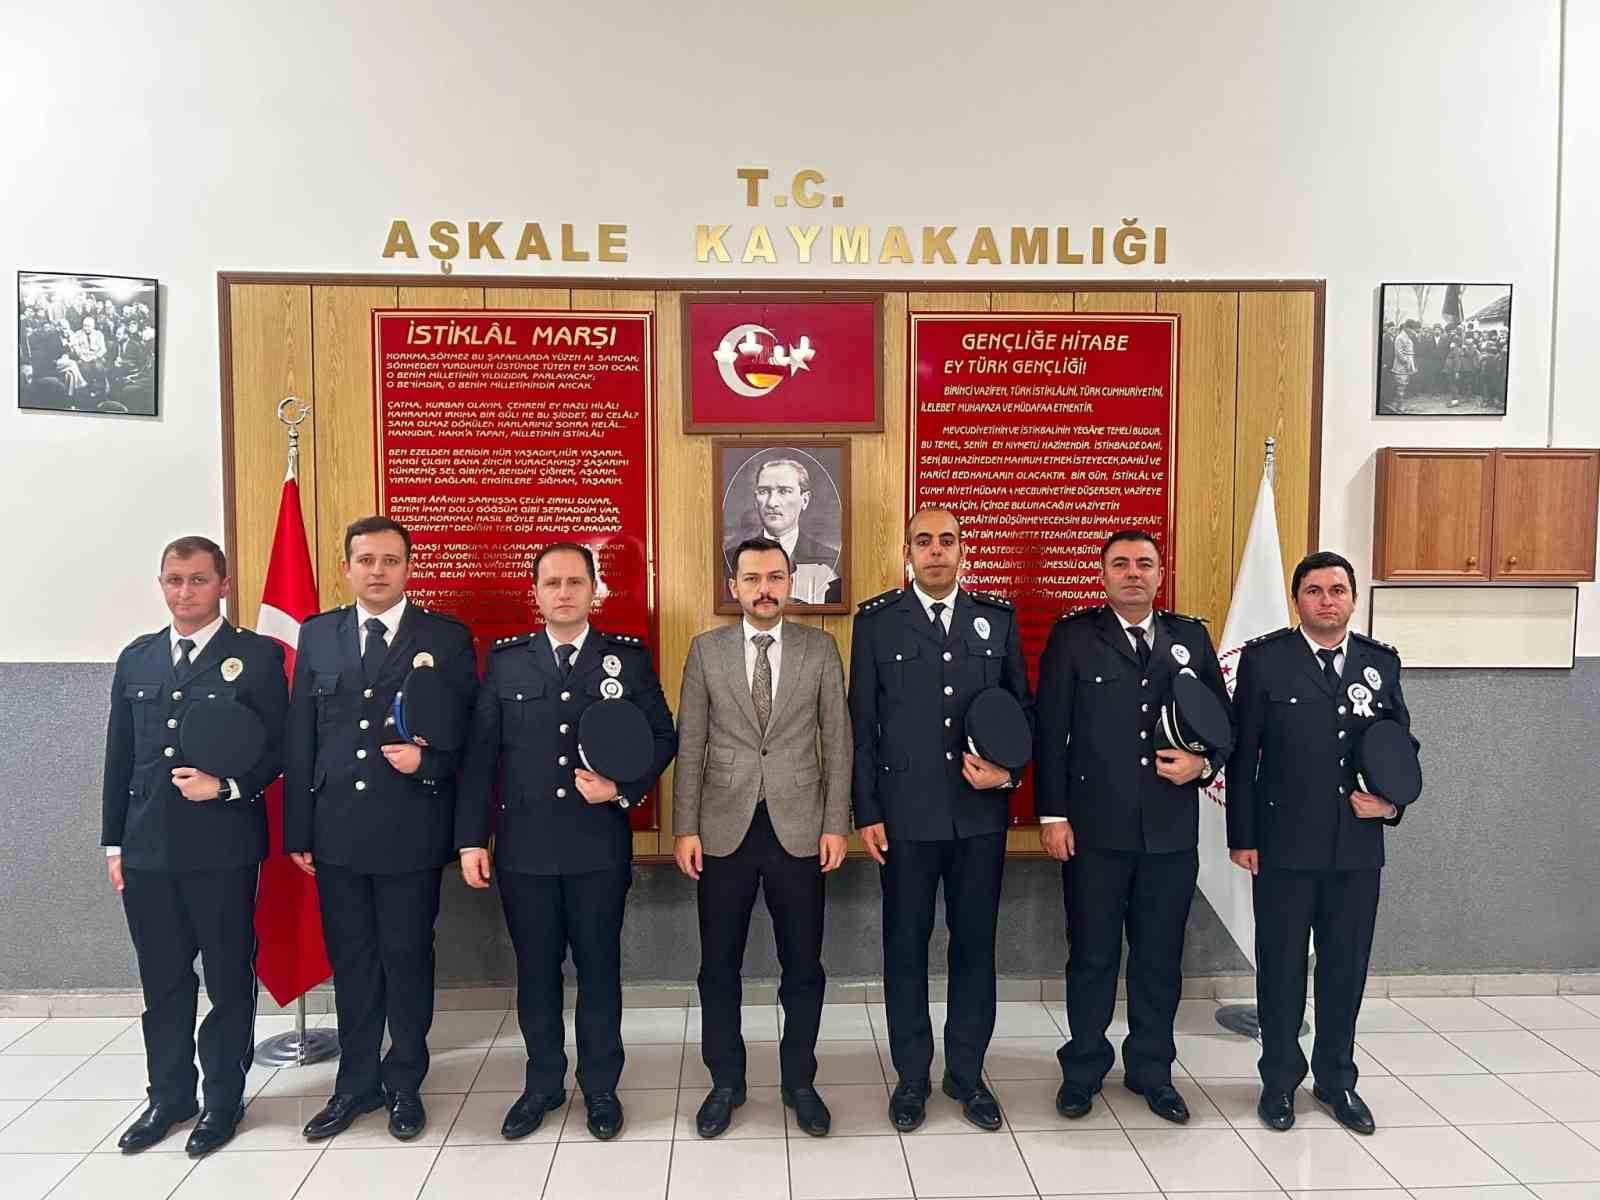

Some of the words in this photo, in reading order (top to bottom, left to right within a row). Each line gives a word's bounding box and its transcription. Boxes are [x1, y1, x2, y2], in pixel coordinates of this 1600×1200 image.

[737, 168, 844, 208] T.C.
[382, 220, 628, 275] AŞKALE
[696, 217, 1167, 265] KAYMAKAMLIĞI
[406, 319, 517, 345] İSTİKLÂL
[532, 326, 617, 349] MARŞI
[961, 330, 1057, 353] GENÇLİĞE
[1060, 330, 1129, 351] HİTABE
[386, 371, 395, 379] O
[944, 360, 964, 374] EY
[968, 356, 1008, 374] TÜRK
[1012, 357, 1087, 376] GENÇLİĞİ!
[386, 381, 395, 389] O
[447, 381, 456, 389] O
[921, 441, 933, 449] BU
